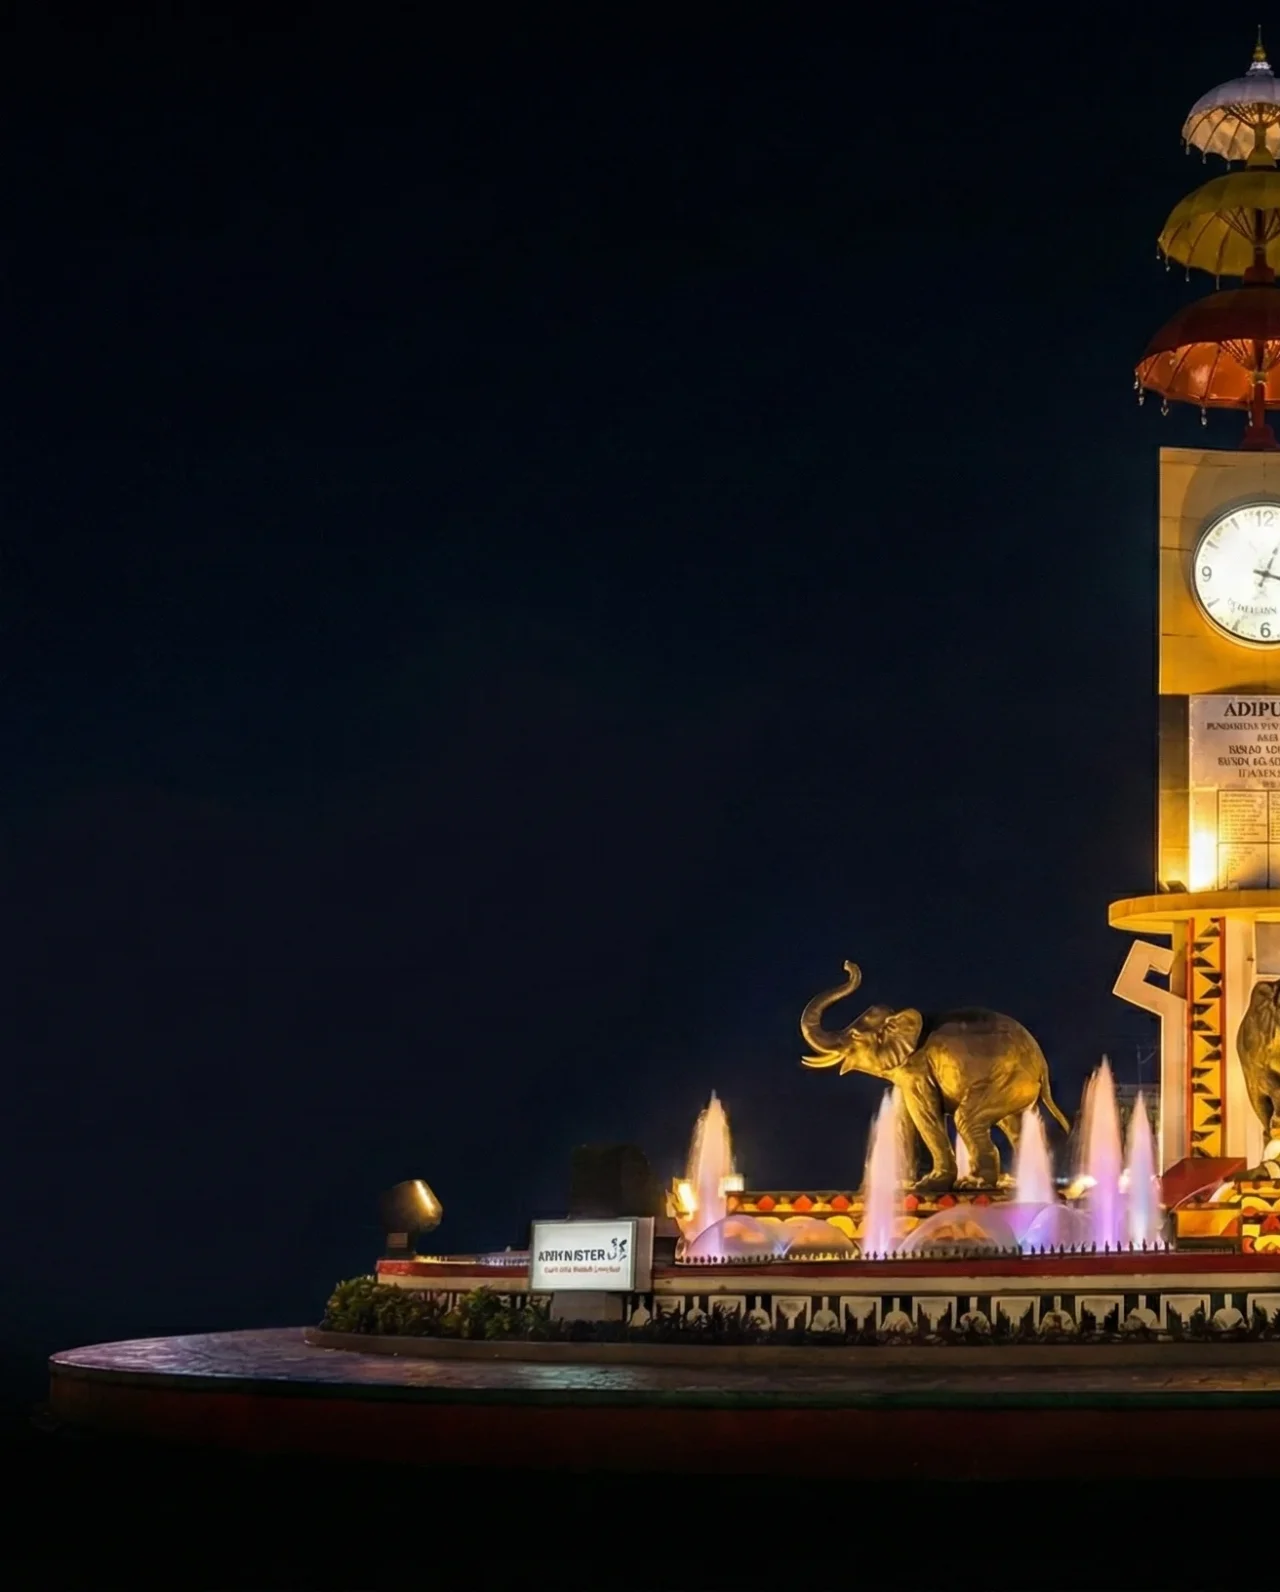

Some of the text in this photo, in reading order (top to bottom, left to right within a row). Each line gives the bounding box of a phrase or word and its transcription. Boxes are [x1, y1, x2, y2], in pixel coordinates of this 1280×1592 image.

[1255, 510, 1274, 527] 12
[1201, 565, 1212, 582] 9
[1260, 622, 1271, 638] 6
